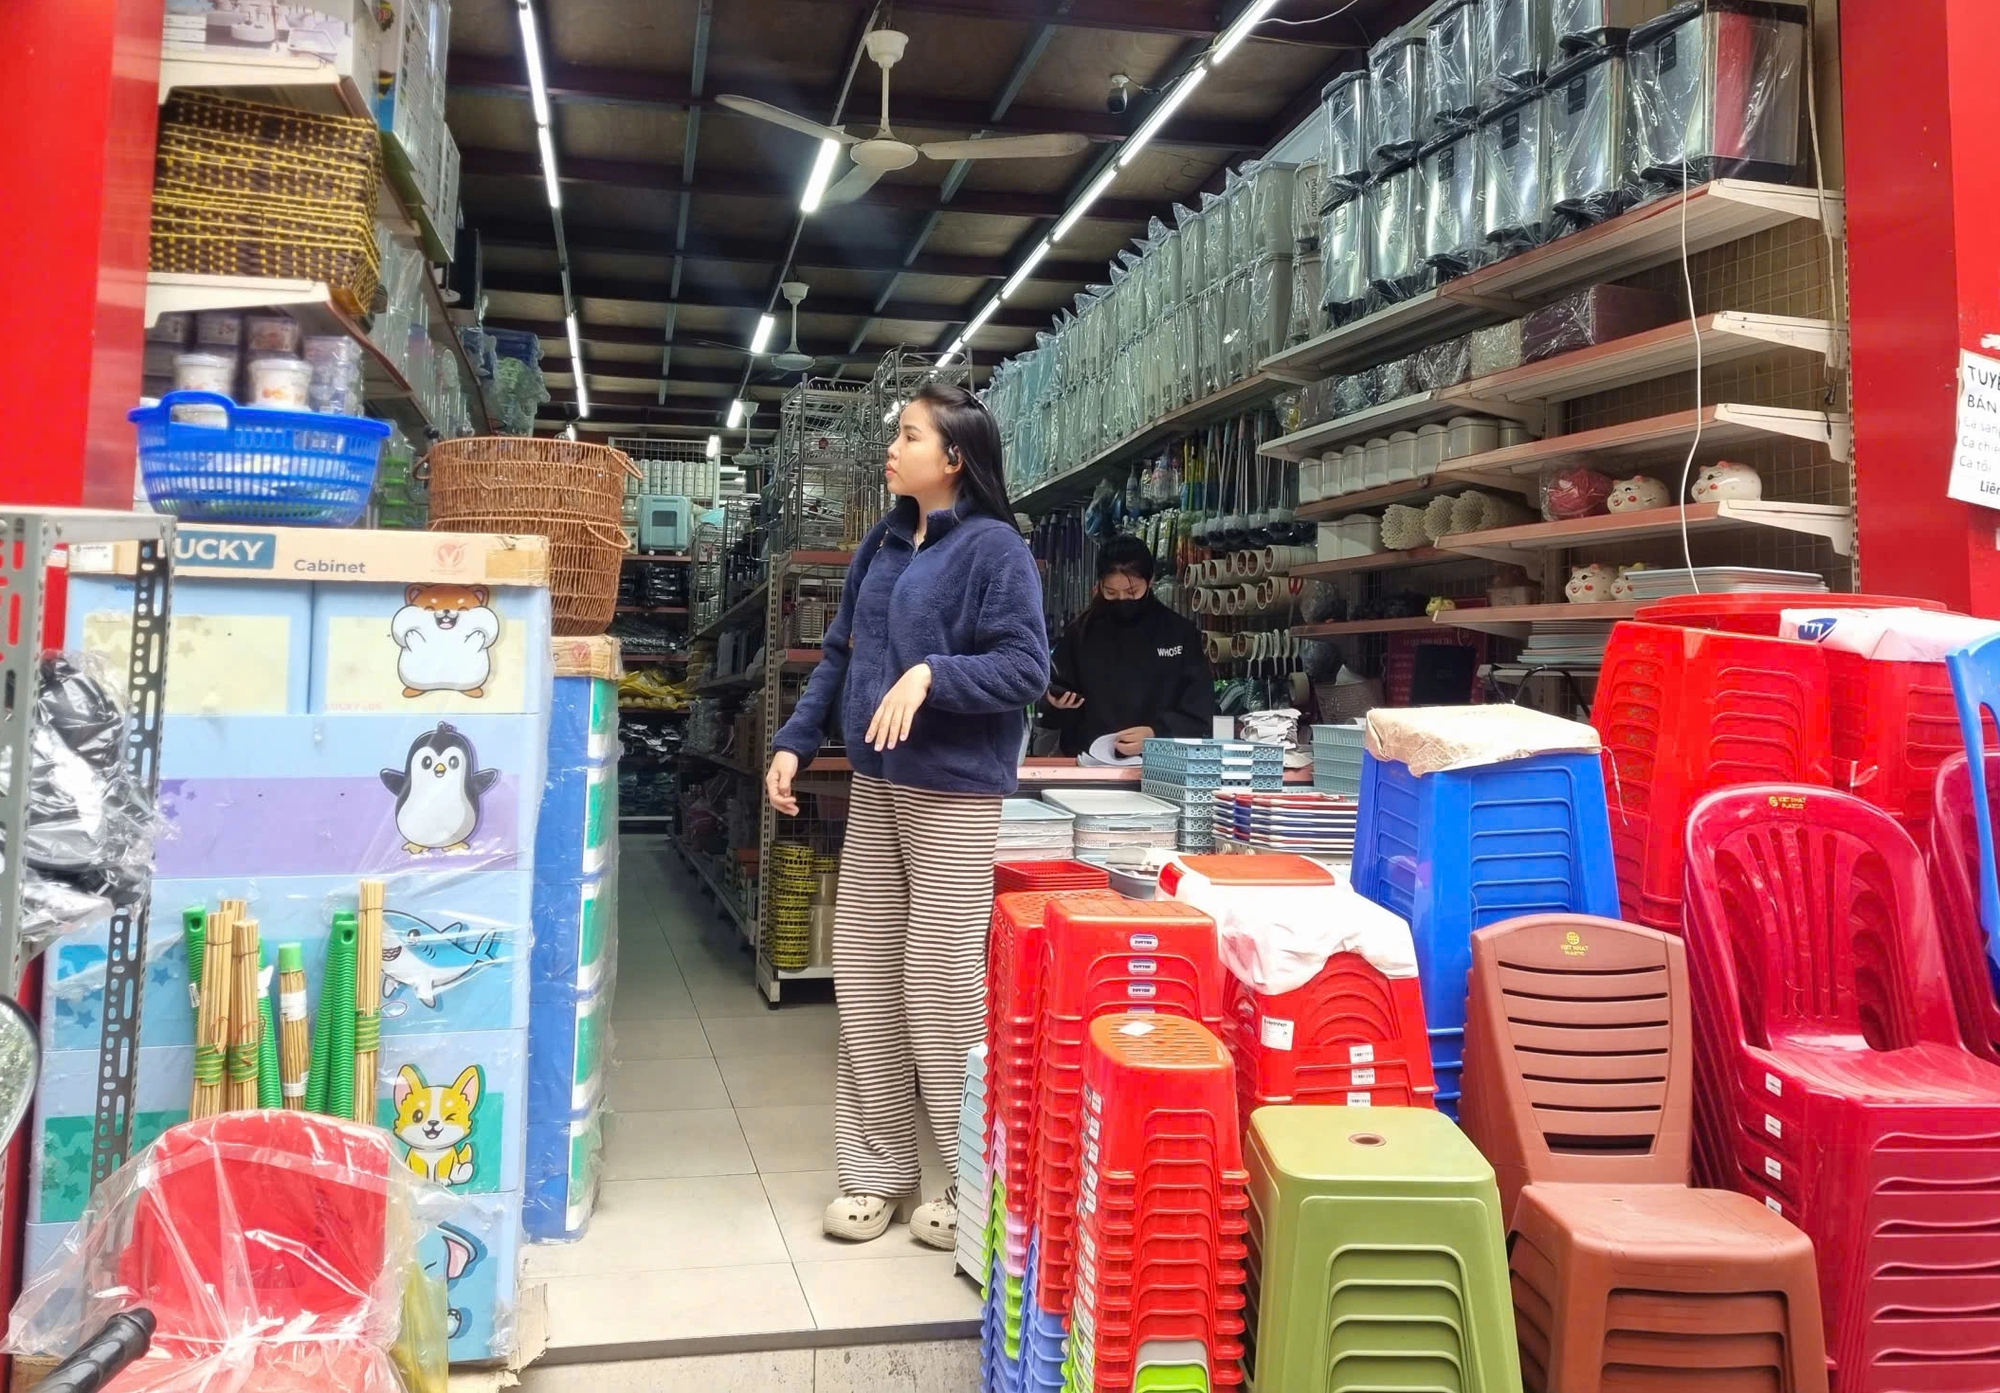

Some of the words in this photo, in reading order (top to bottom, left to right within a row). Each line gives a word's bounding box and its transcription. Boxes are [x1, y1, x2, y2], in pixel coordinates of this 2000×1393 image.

[1967, 394, 1997, 414] BÁN
[1961, 435, 1975, 448] Ca
[1959, 455, 1973, 468] Ca
[294, 559, 366, 574] Cabinet
[1157, 645, 1184, 657] WHOSE
